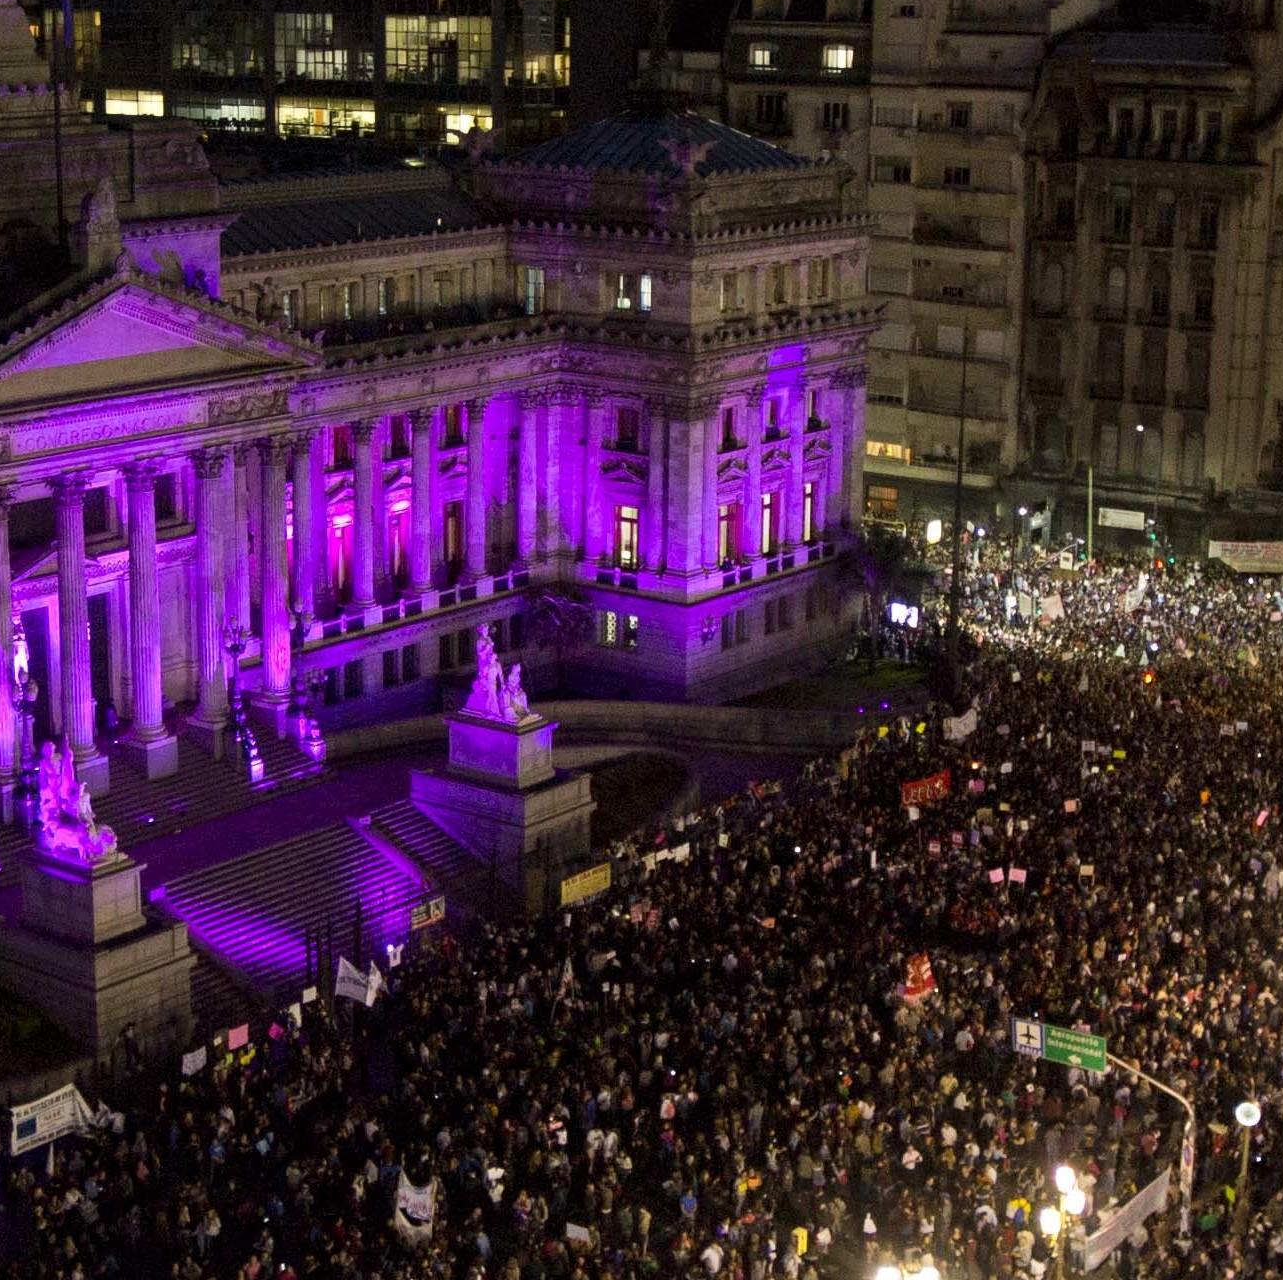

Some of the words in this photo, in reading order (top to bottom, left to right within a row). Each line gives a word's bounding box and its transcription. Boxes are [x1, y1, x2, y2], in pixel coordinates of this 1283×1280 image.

[24, 423, 111, 453] CONGRESO
[120, 413, 192, 435] NACIONAL
[1051, 1029, 1099, 1047] Aeropuerto
